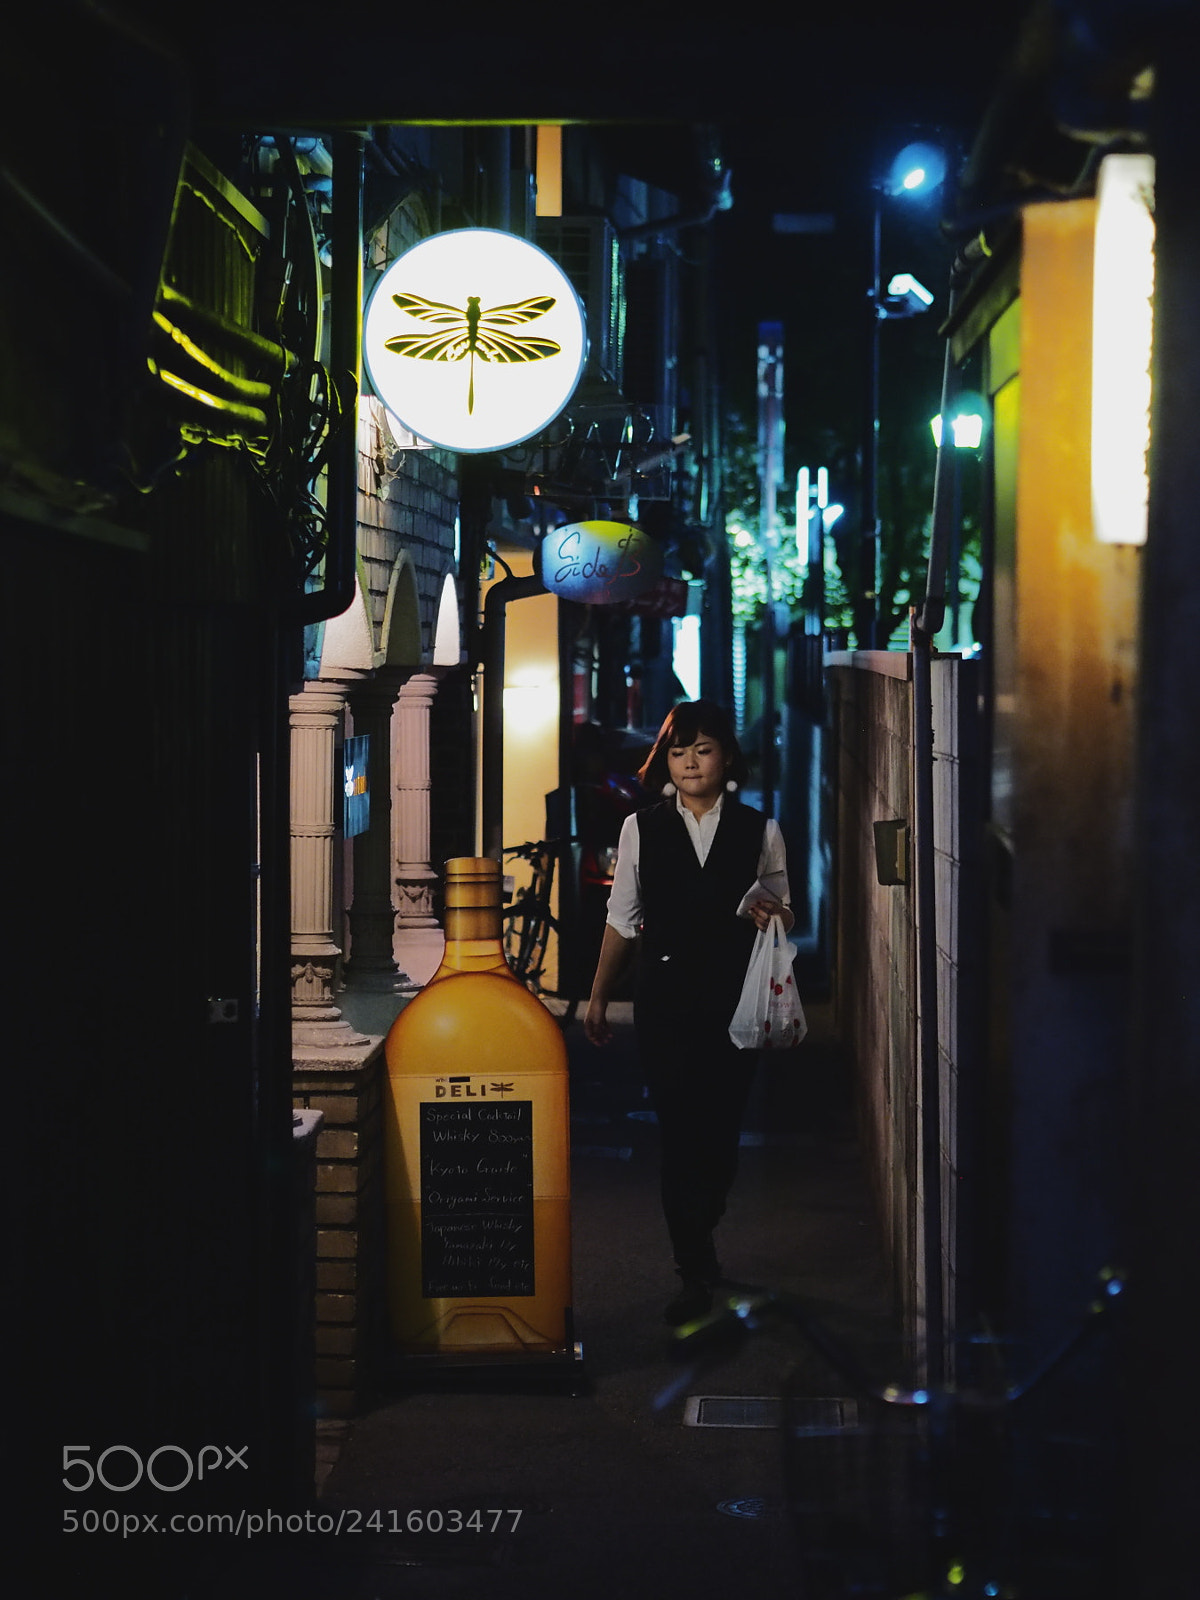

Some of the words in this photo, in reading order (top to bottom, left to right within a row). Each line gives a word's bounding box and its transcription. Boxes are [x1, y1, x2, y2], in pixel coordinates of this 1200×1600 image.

[435, 1084, 487, 1098] DELI
[426, 1107, 472, 1125] Special
[432, 1128, 480, 1143] Whisky
